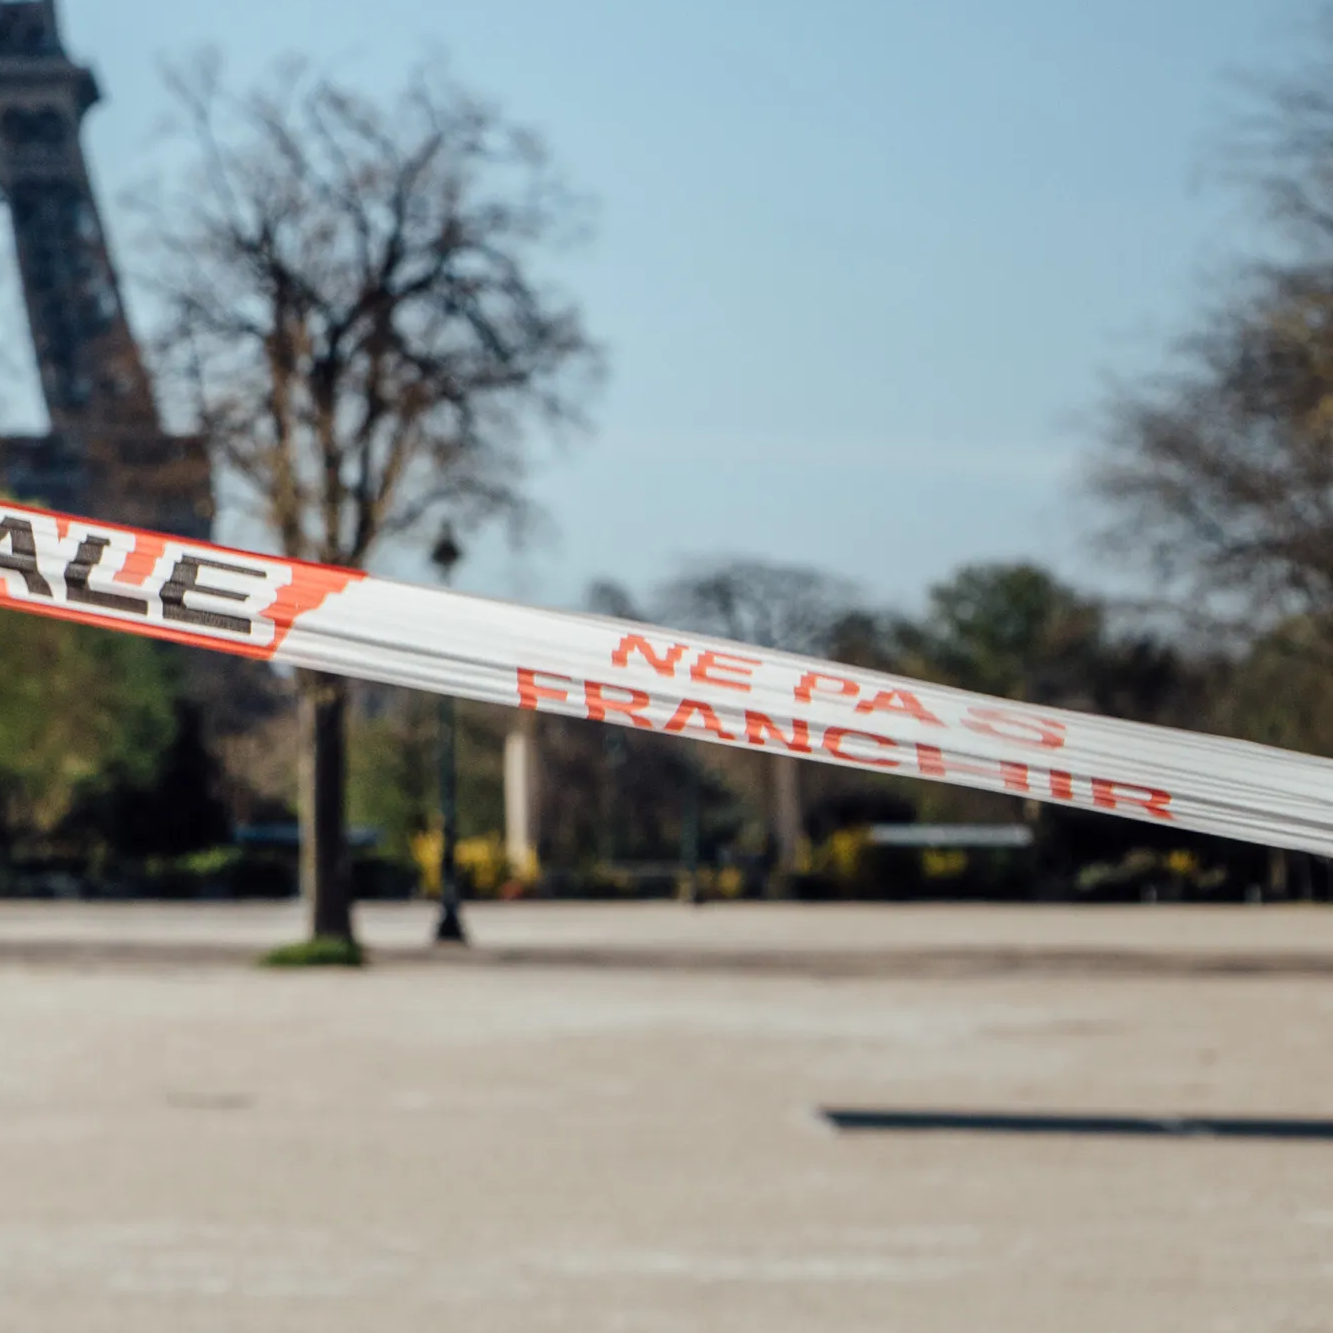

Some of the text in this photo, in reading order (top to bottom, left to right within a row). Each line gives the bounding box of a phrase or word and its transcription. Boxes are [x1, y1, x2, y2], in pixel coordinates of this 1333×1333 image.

[517, 667, 1176, 821] FRANCHIR
[611, 633, 1066, 749] NE PAS
